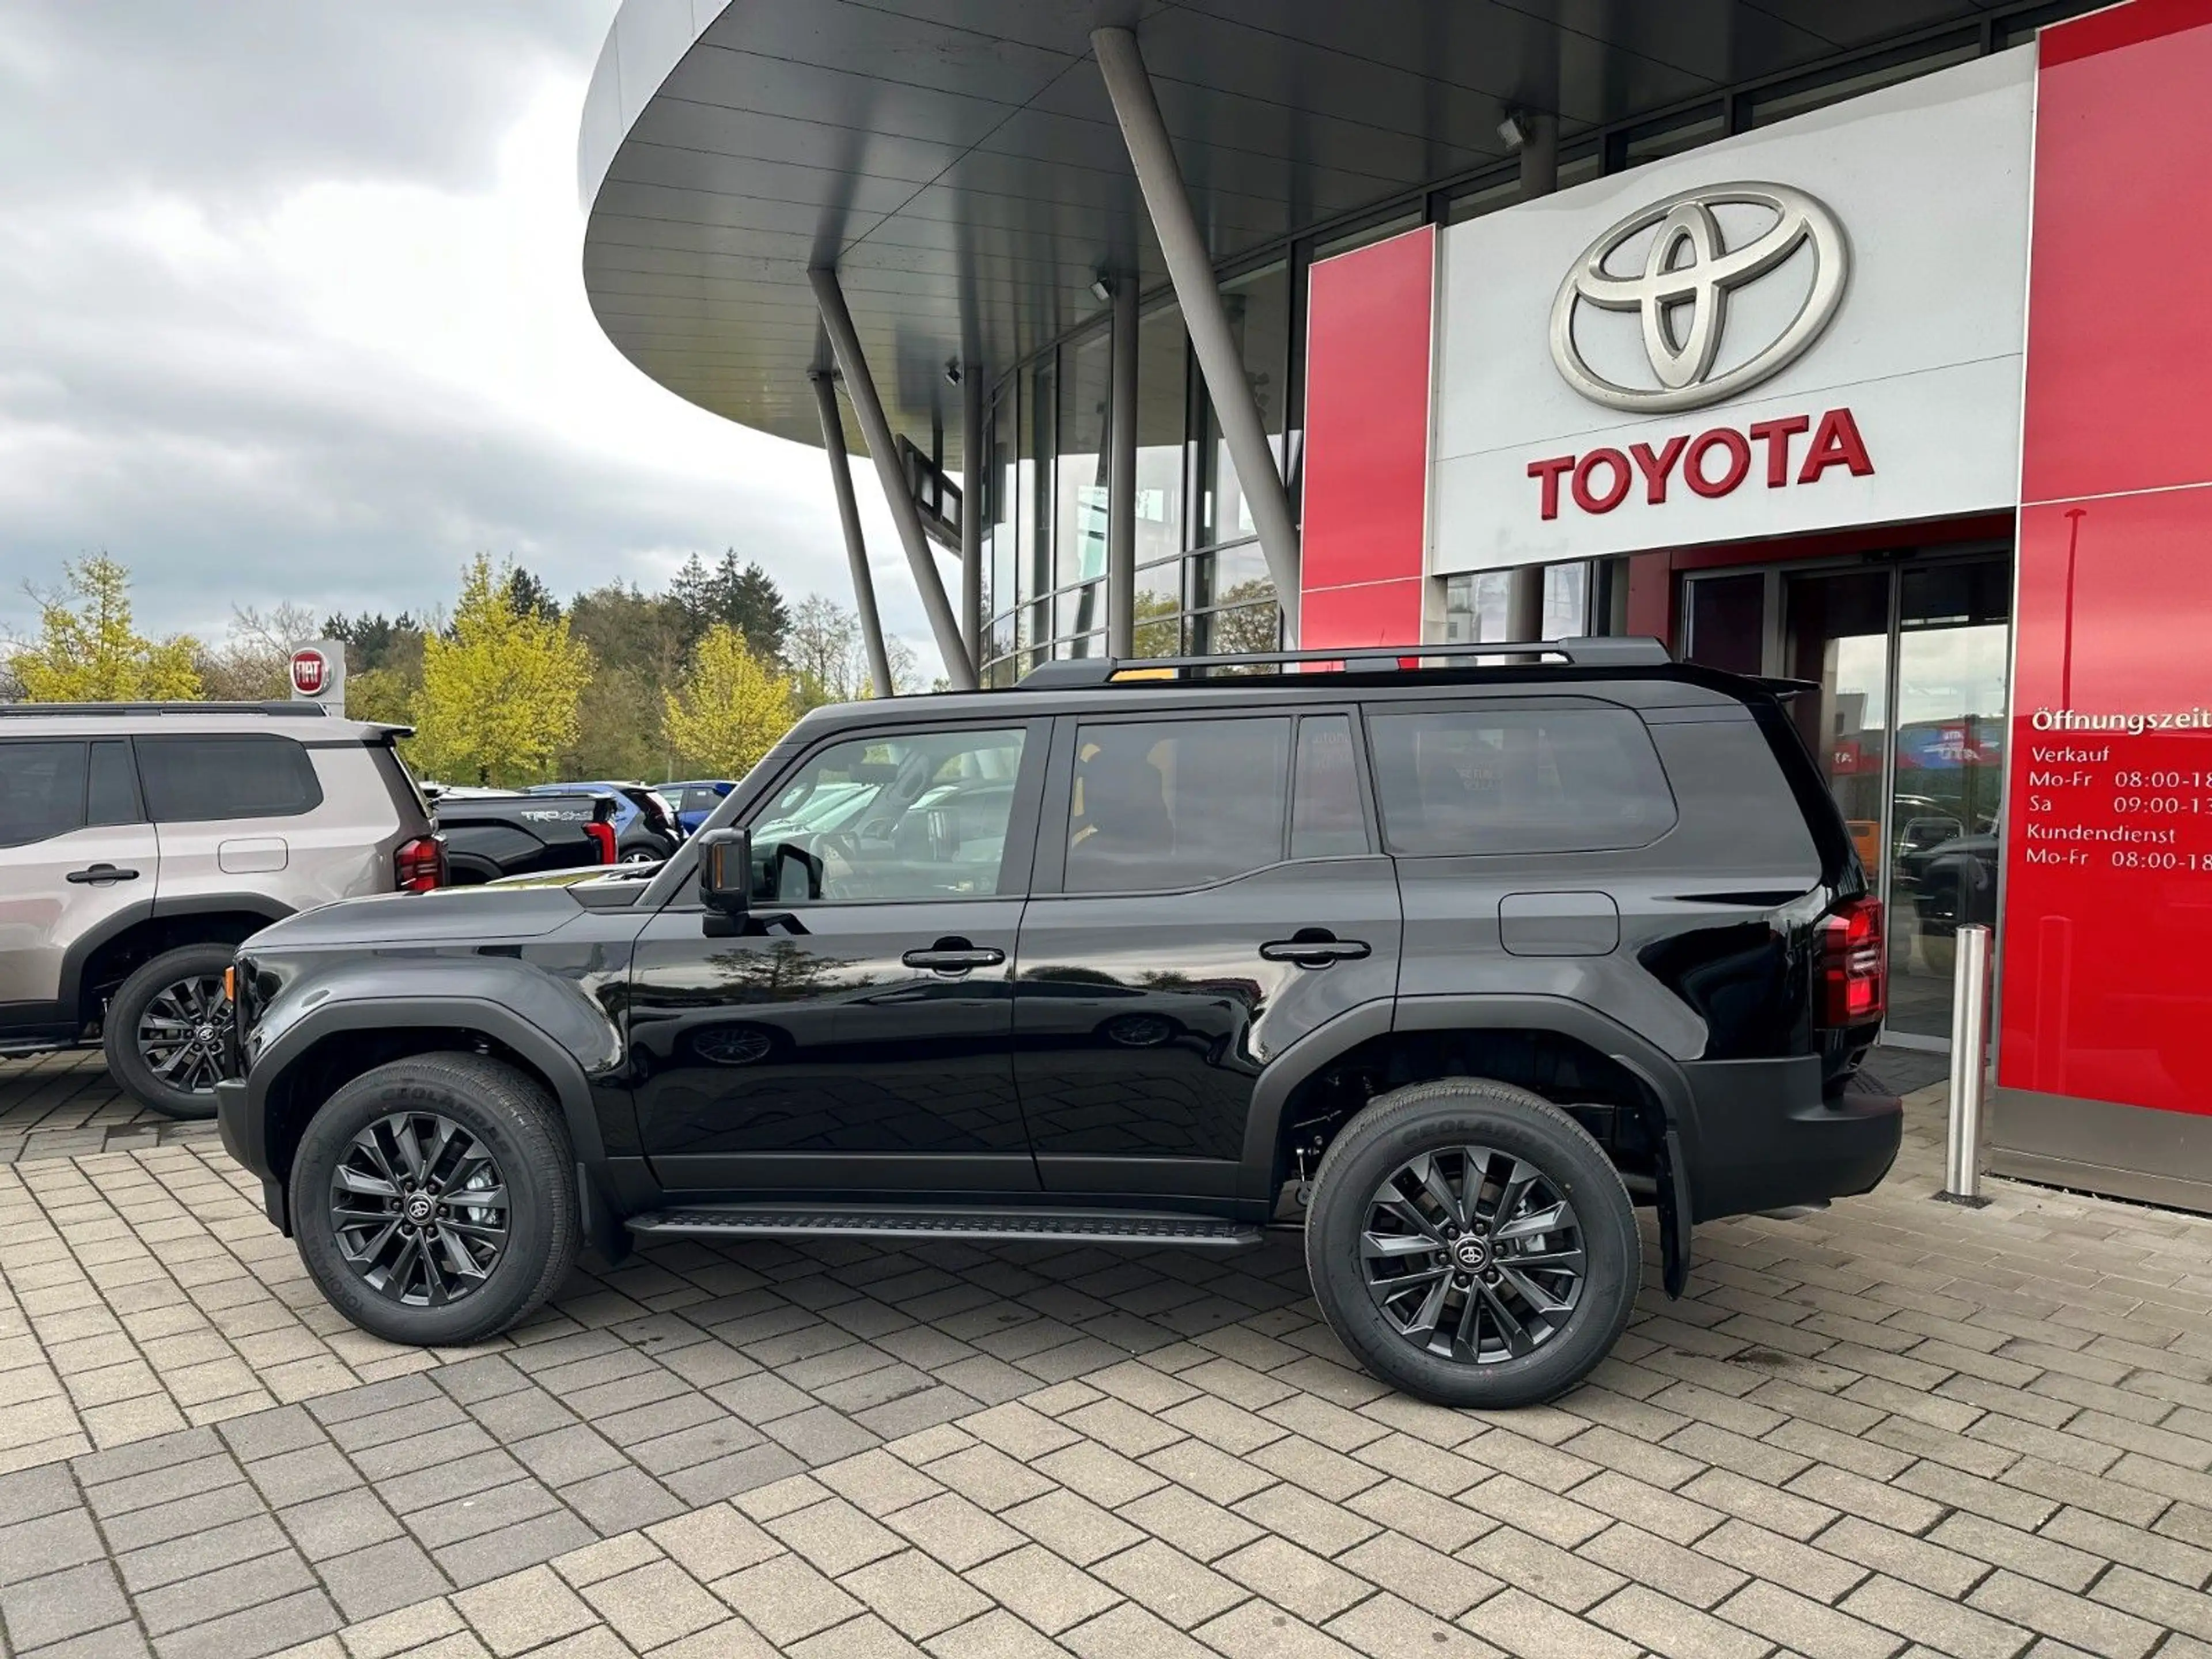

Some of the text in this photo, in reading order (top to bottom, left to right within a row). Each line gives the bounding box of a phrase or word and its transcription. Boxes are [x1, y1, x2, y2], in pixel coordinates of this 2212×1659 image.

[1528, 408, 1874, 521] TOYOTA
[296, 661, 320, 684] FIAT
[2032, 707, 2212, 736] Öffnungszeit
[2032, 747, 2109, 763] Verkauf
[2029, 771, 2092, 787] Mo-Fr
[2029, 795, 2052, 812] Sa
[2027, 824, 2176, 844] Kundendienst
[2026, 848, 2212, 872] Mo-Fr 08:00-18
